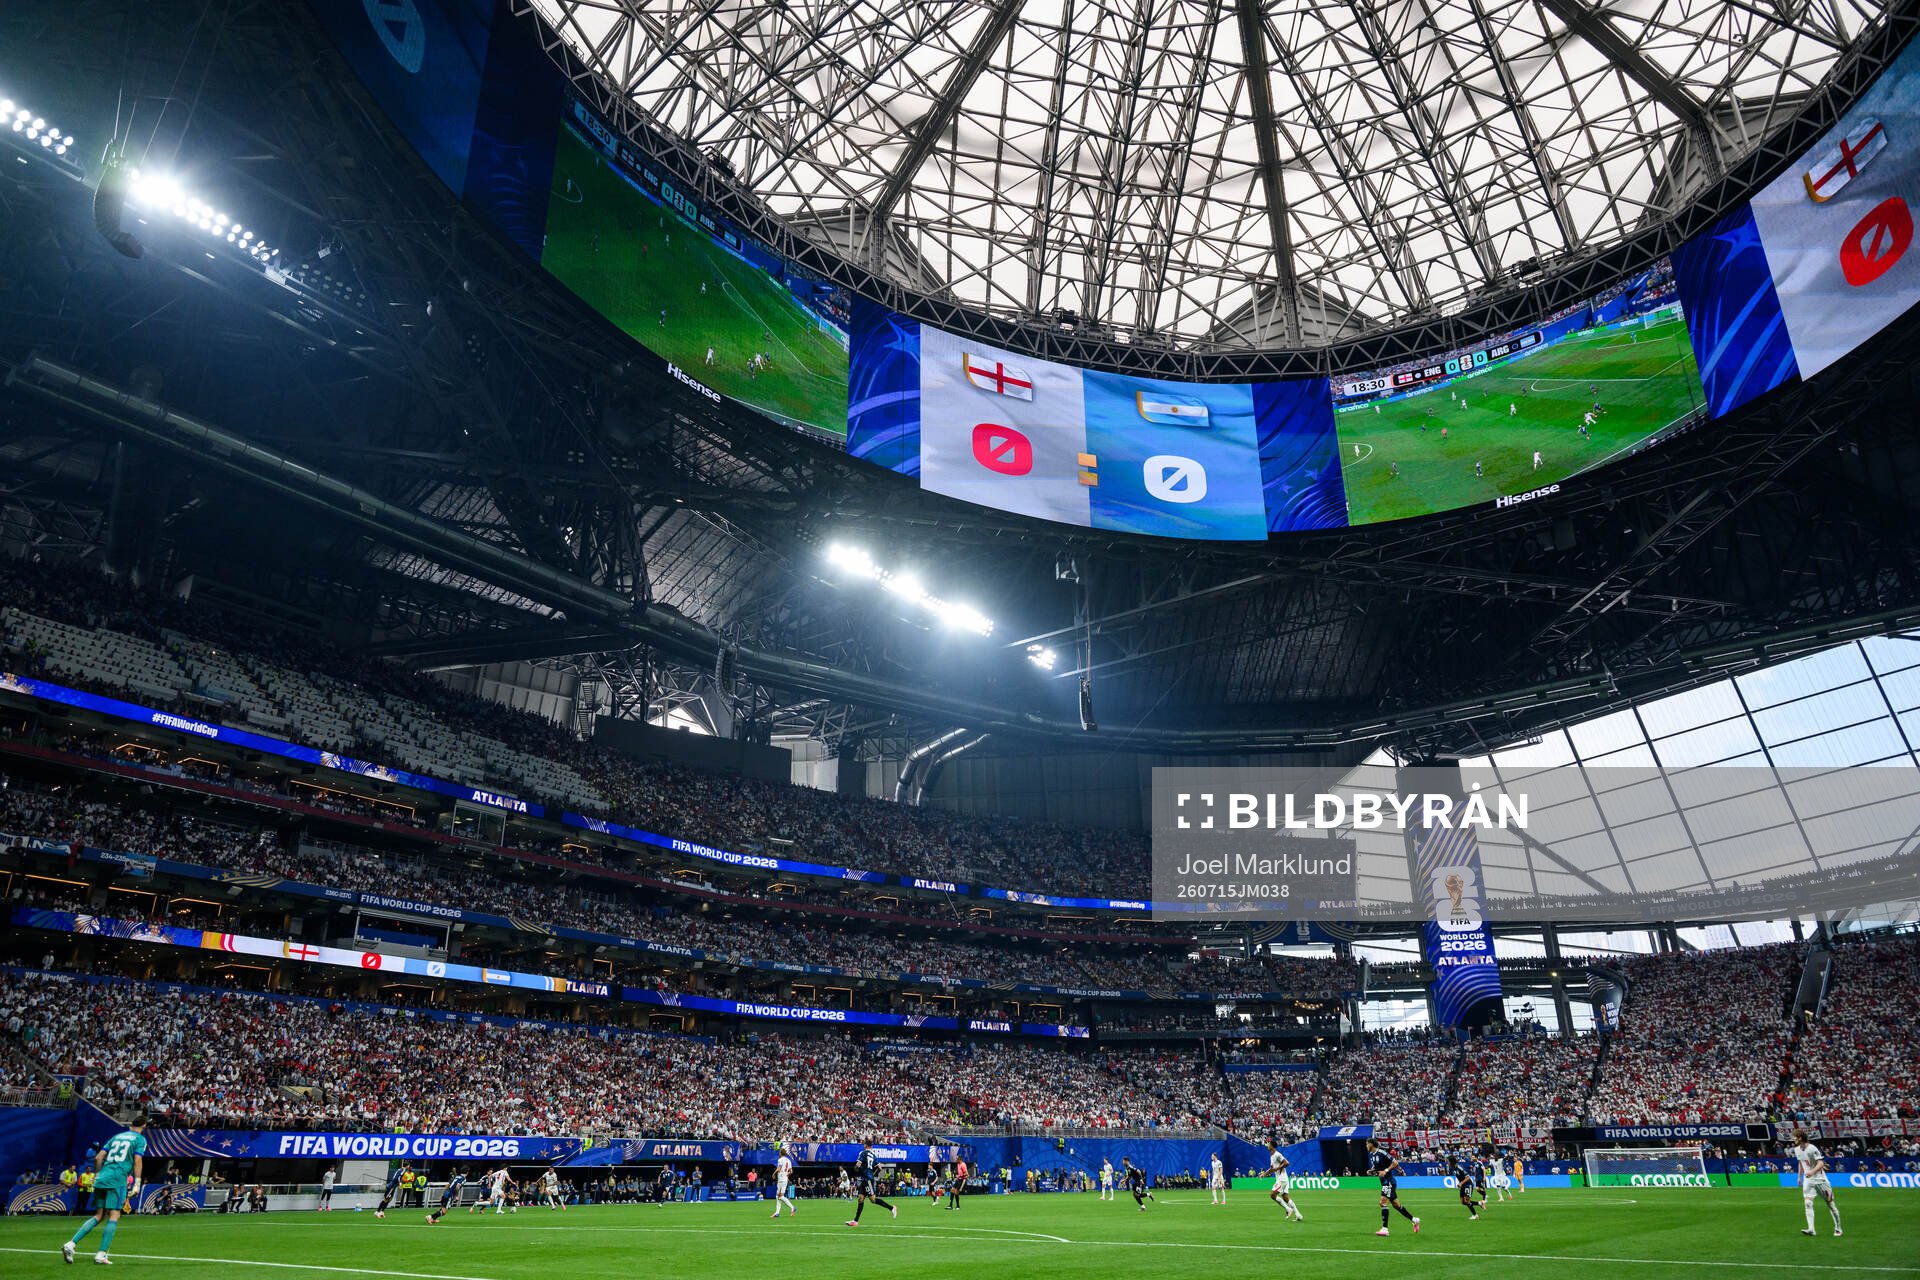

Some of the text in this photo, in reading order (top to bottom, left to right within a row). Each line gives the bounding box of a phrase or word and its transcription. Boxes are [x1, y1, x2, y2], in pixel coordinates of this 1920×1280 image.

[1491, 345, 1509, 358] ARG
[1424, 366, 1441, 378] ENG
[667, 362, 722, 403] Hisense
[1351, 379, 1386, 394] 18:30
[1496, 484, 1560, 508] Hisense
[152, 713, 218, 738] #FIFAWorldCup
[472, 790, 527, 813] ATLANTA
[672, 839, 778, 868] FIFA WORLD CUP 2026
[914, 879, 956, 892] ATLANTA
[360, 894, 462, 918] FIFA WORLD CUP 2026
[1319, 900, 1359, 909] ATLANT
[1450, 918, 1471, 926] FIFA
[647, 943, 692, 956] ATLANTA
[1440, 940, 1487, 952] 2026
[1438, 955, 1494, 966] ATLANTA
[566, 980, 608, 996] TLANTA
[736, 1003, 846, 1021] FIFA WORLD CUP 2026
[970, 1021, 1010, 1031] ATLANTA
[1604, 1125, 1742, 1138] FIFA WORLD CUP 2026
[106, 1140, 131, 1163] 23
[279, 1135, 519, 1157] FIFA WORLD CUP 2026
[653, 1144, 702, 1157] ATLANTA
[1289, 1176, 1340, 1189] ramco
